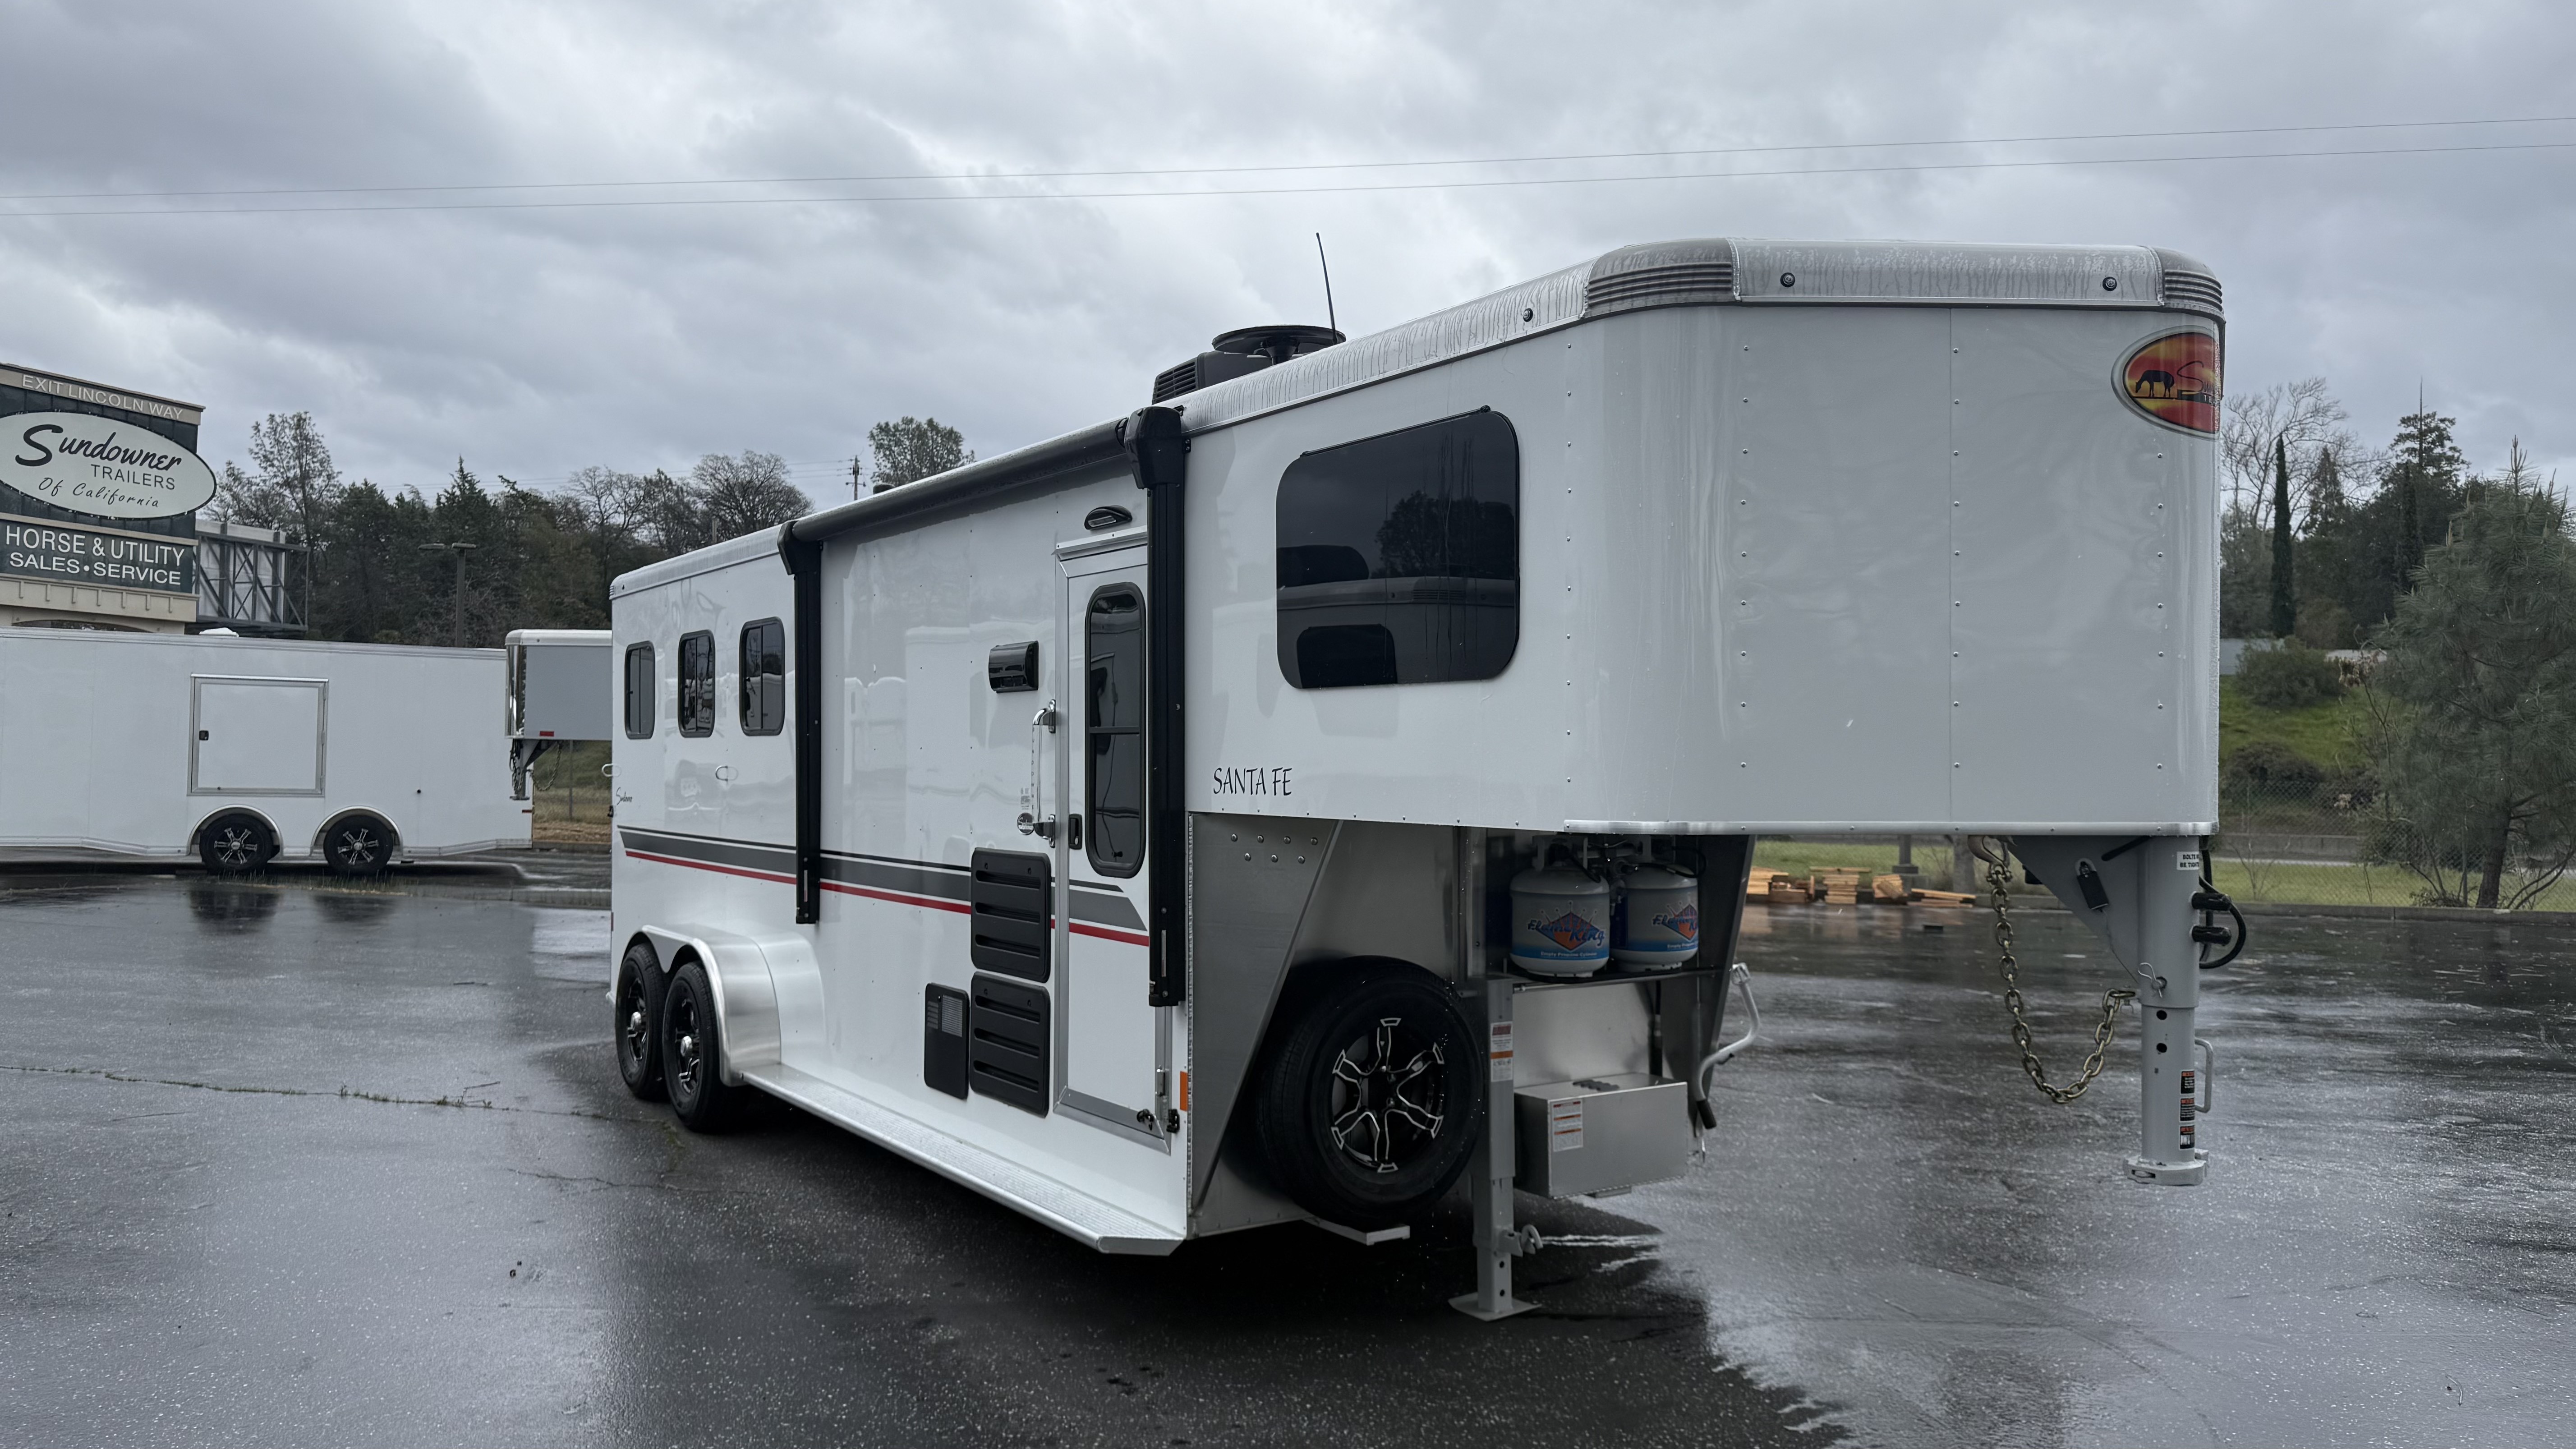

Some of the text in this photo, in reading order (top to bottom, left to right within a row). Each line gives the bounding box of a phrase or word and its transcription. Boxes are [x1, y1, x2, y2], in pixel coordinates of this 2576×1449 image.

[22, 374, 183, 420] EXIT LINCOLN WAY
[15, 424, 182, 471] Sundowner
[38, 477, 159, 507] Of California
[91, 464, 175, 490] TRAILERS
[6, 525, 185, 566] HORSE & UTILITY
[1213, 767, 1293, 796] SANTA FE
